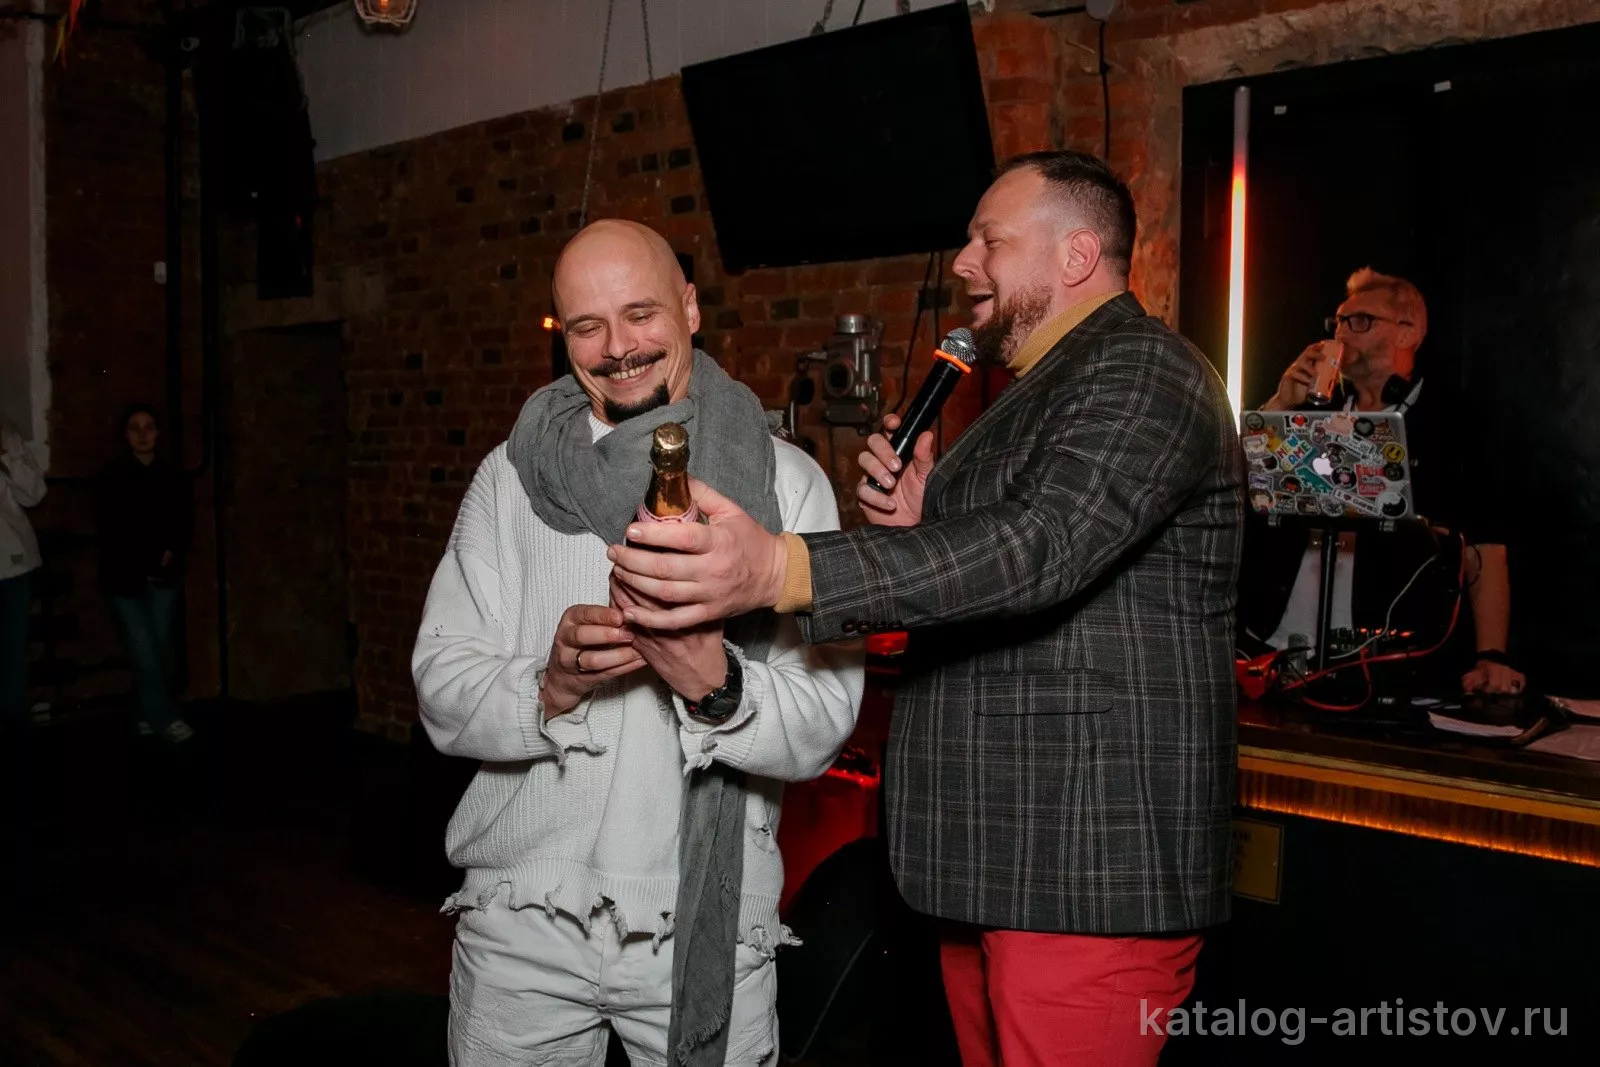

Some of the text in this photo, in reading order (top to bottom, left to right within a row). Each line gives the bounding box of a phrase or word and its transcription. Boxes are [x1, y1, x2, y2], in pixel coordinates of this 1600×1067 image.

[1284, 415, 1291, 428] I
[1276, 435, 1299, 459] NEW
[1281, 441, 1311, 471] GAME
